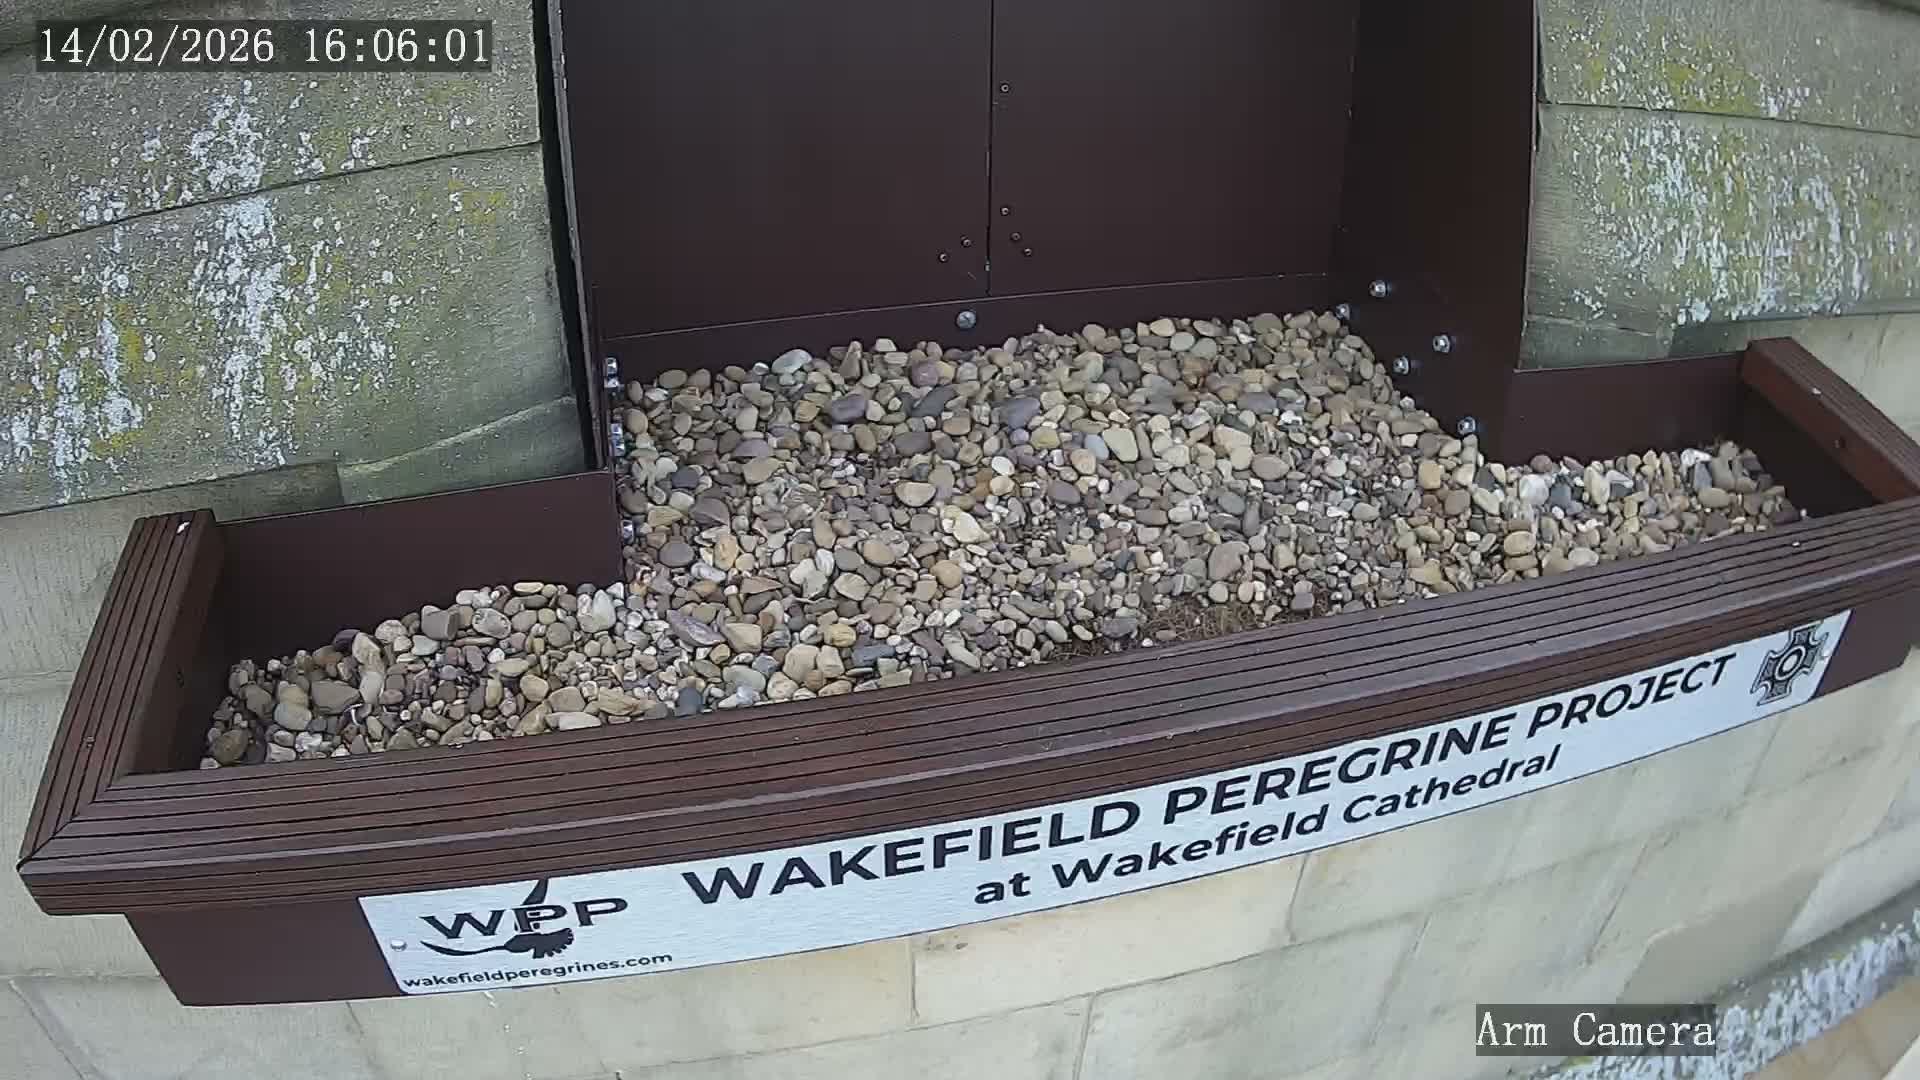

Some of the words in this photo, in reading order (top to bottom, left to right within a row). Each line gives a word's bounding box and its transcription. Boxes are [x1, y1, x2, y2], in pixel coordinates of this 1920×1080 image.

[681, 801, 1141, 905] WAKEFIELD
[1163, 711, 1518, 825] PEREGRINE
[1526, 653, 1736, 739] PROJECT
[974, 871, 1031, 905] at
[1051, 803, 1330, 889] Wakefield
[1342, 744, 1562, 824] Cathedral
[419, 896, 628, 940] WPP
[403, 952, 674, 989] wakefieldperegrines.com
